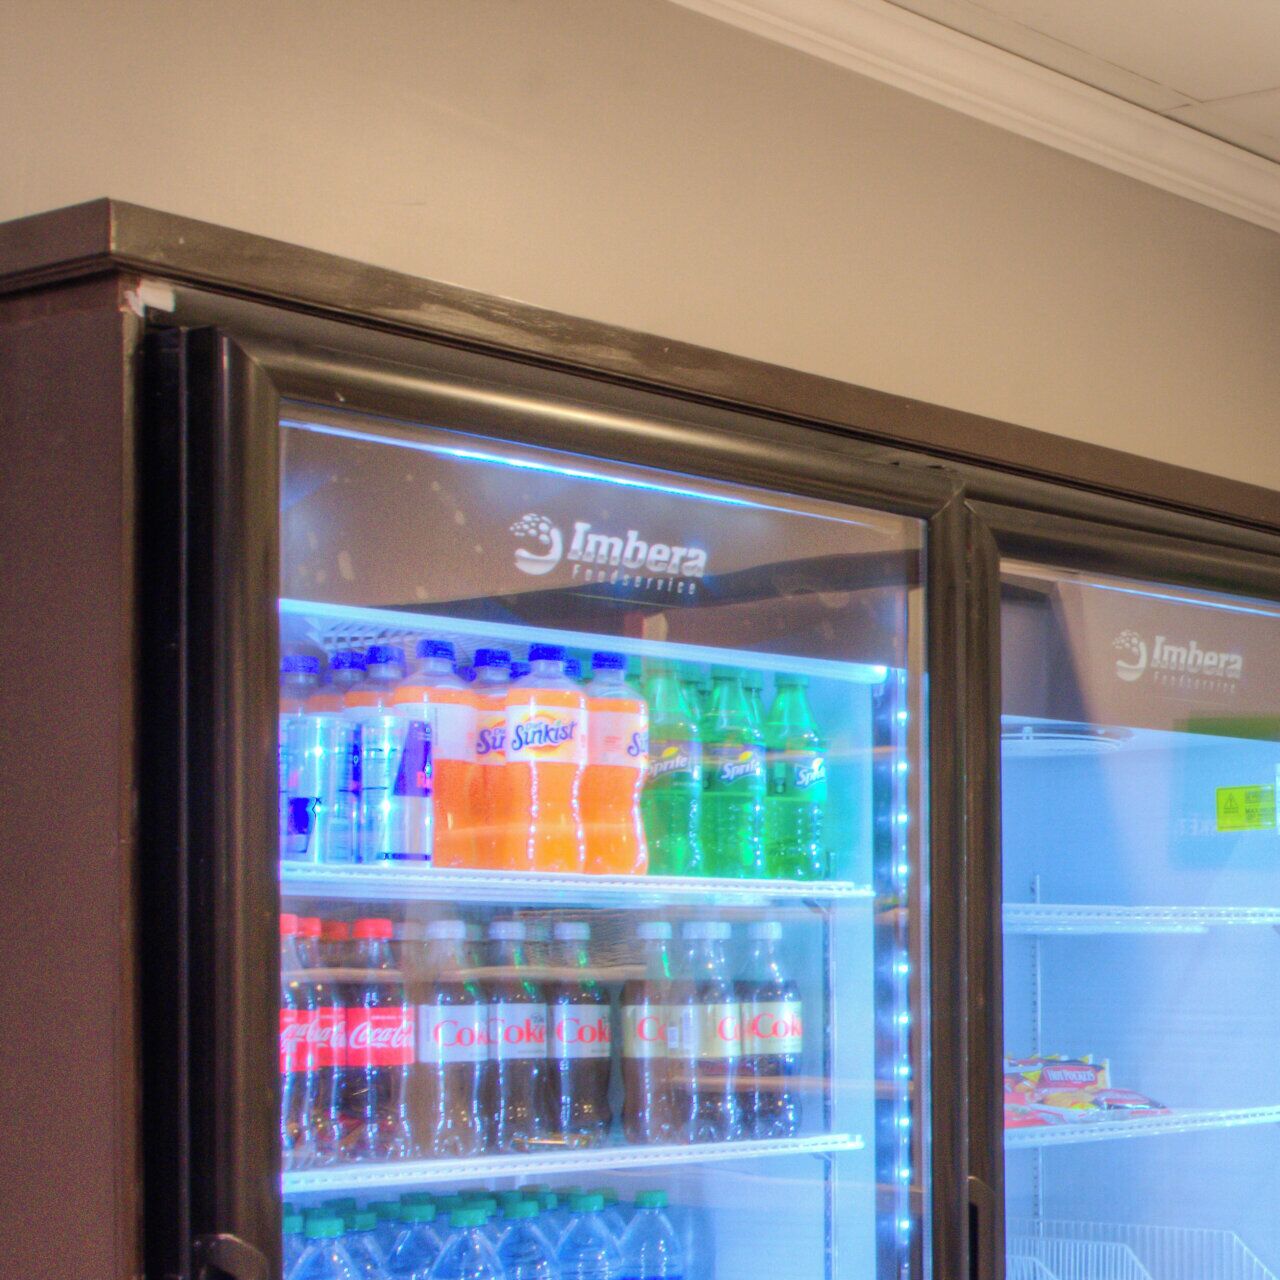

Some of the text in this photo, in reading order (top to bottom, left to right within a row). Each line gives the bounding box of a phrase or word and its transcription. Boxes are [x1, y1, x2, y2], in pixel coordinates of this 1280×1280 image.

[567, 521, 708, 578] Imbera
[572, 564, 697, 594] Foodservice
[1151, 635, 1243, 678] Imbera
[511, 720, 577, 751] Sunkist
